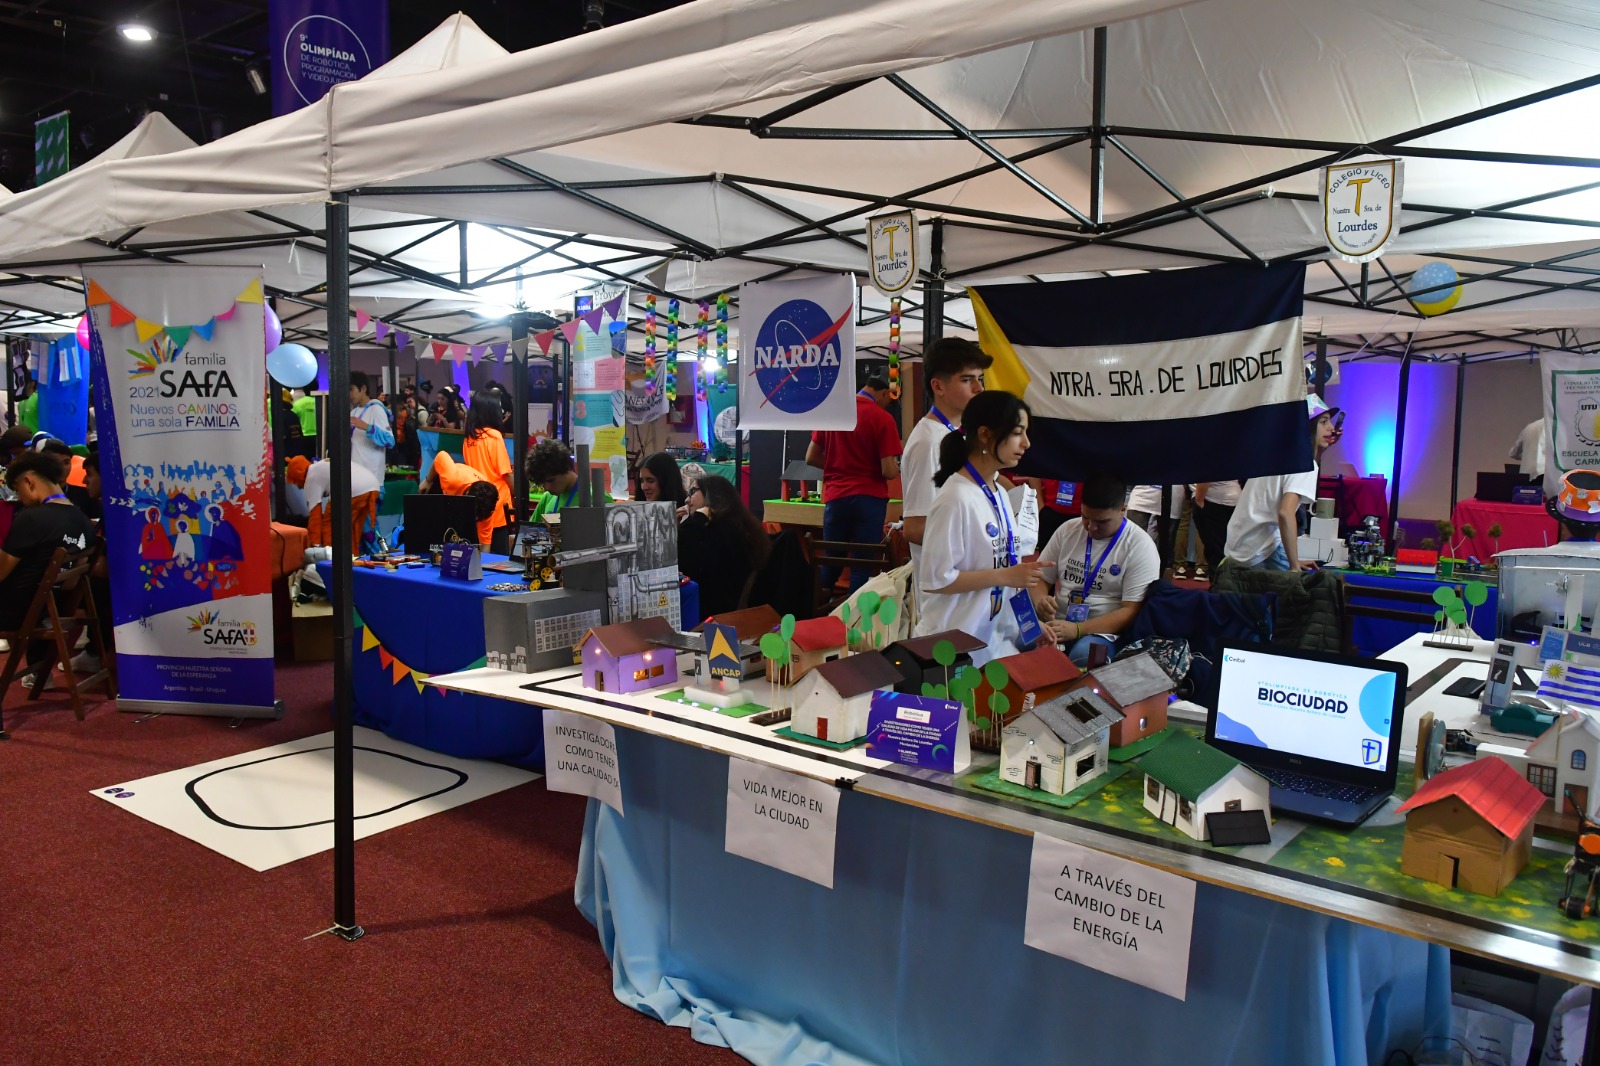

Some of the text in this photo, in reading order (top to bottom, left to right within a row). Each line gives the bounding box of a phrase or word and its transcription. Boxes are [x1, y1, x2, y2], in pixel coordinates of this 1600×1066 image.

[300, 42, 356, 62] OLIMPÍADA
[301, 53, 311, 62] DE
[1330, 168, 1362, 194] COLEGIO
[1371, 169, 1390, 189] LICEO
[874, 219, 892, 239] COLEGIO
[897, 219, 909, 233] LICEO
[1338, 220, 1378, 233] Lourdes
[878, 259, 907, 272] Lourdes
[184, 352, 226, 366] familia
[756, 343, 839, 369] NARDA
[1050, 371, 1102, 397] NTRA.
[1158, 366, 1185, 394] DE
[1197, 348, 1283, 390] LOURDES
[130, 387, 160, 398] 2021
[130, 403, 240, 416] Nuevos CAMINOS,
[576, 400, 586, 419] 3
[132, 416, 239, 427] una sola FAMILIA
[1064, 570, 1103, 590] Loures
[711, 667, 741, 677] ANCAP
[1258, 687, 1348, 714] BIOCIUDAD
[565, 744, 615, 769] COMO TENER
[558, 760, 579, 772] UNA
[581, 764, 612, 784] CALIDAD
[743, 779, 823, 813] VIDA MEJOR EN
[754, 803, 809, 830] LA CIUDAD
[1060, 865, 1165, 908] A TRAVÉS DEL
[1055, 888, 1163, 934] CAMBIO DE LA
[1073, 918, 1138, 951] ENERGÍA
